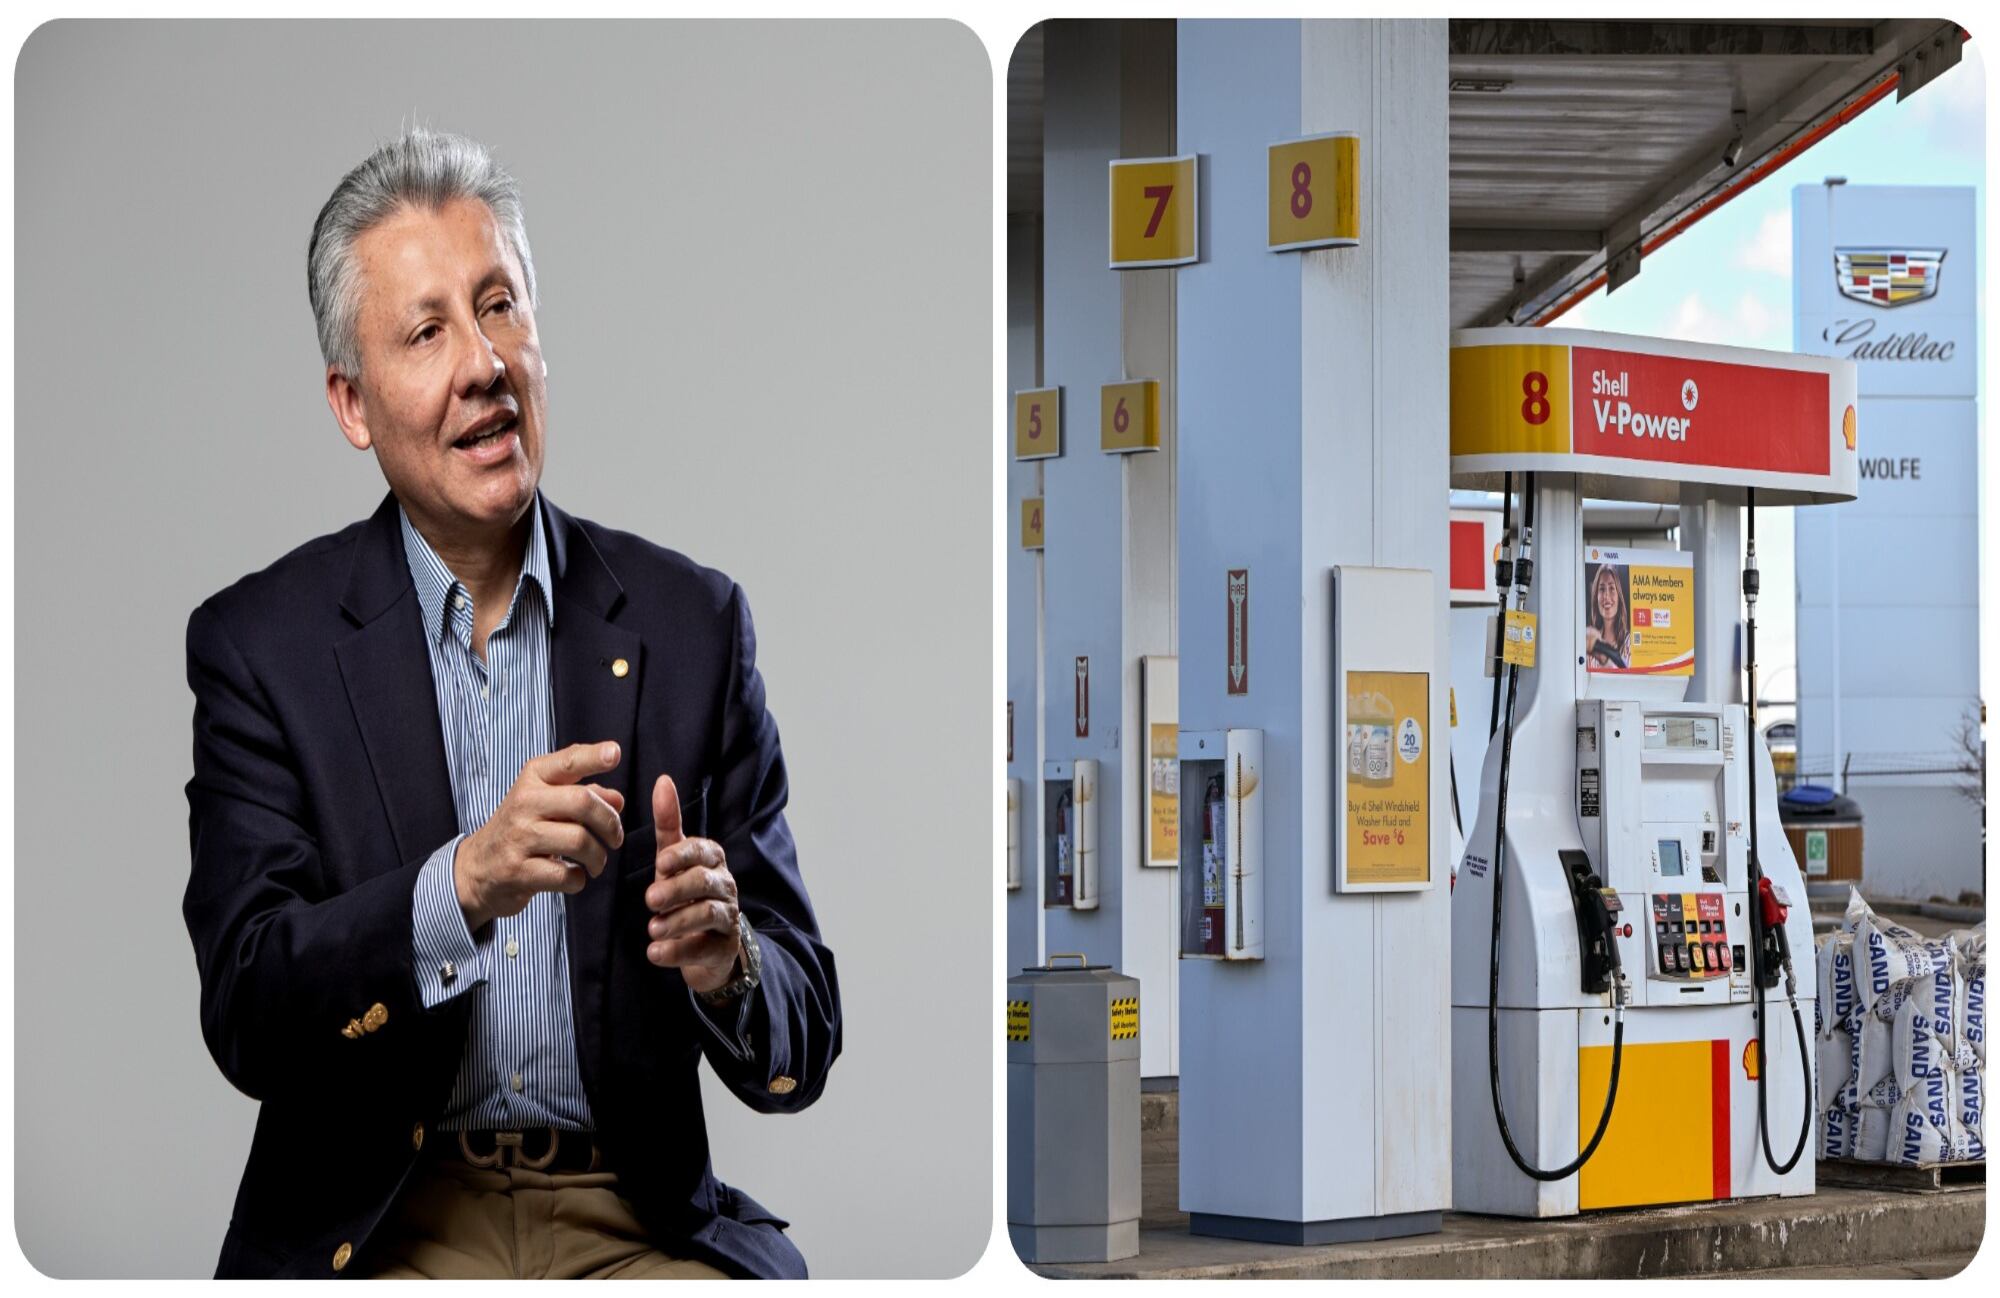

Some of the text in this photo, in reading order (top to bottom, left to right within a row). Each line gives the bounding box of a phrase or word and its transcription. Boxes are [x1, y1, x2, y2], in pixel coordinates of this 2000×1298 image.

[1144, 185, 1174, 238] 7
[1290, 161, 1313, 219] 8
[1823, 318, 1955, 361] Cadillac
[1521, 371, 1551, 425] 8
[1592, 369, 1629, 397] Shell
[1028, 404, 1041, 439] 5
[1113, 397, 1129, 433] 6
[1592, 398, 1691, 441] V-Power
[1859, 458, 1921, 479] WOLFE
[1030, 508, 1041, 534] 4
[1231, 584, 1245, 596] FIRE
[1632, 575, 1684, 588] AMA Members
[1632, 589, 1675, 604] always save
[1404, 733, 1416, 746] 20
[1348, 801, 1360, 814] Buy
[1368, 800, 1384, 812] Shell
[1385, 800, 1420, 812] Windshield
[1357, 815, 1411, 827] Washer Fluid and
[1363, 830, 1391, 845] Save
[1869, 932, 1889, 994] SAND
[1835, 954, 1851, 1016] SAND
[1935, 973, 1951, 1035] SAND
[1967, 978, 1984, 1043] SAND
[1912, 1014, 1930, 1079] SAND
[1927, 1067, 1946, 1127] SAND
[1826, 1110, 1843, 1159] SAN
[1902, 1112, 1924, 1164] SAN
